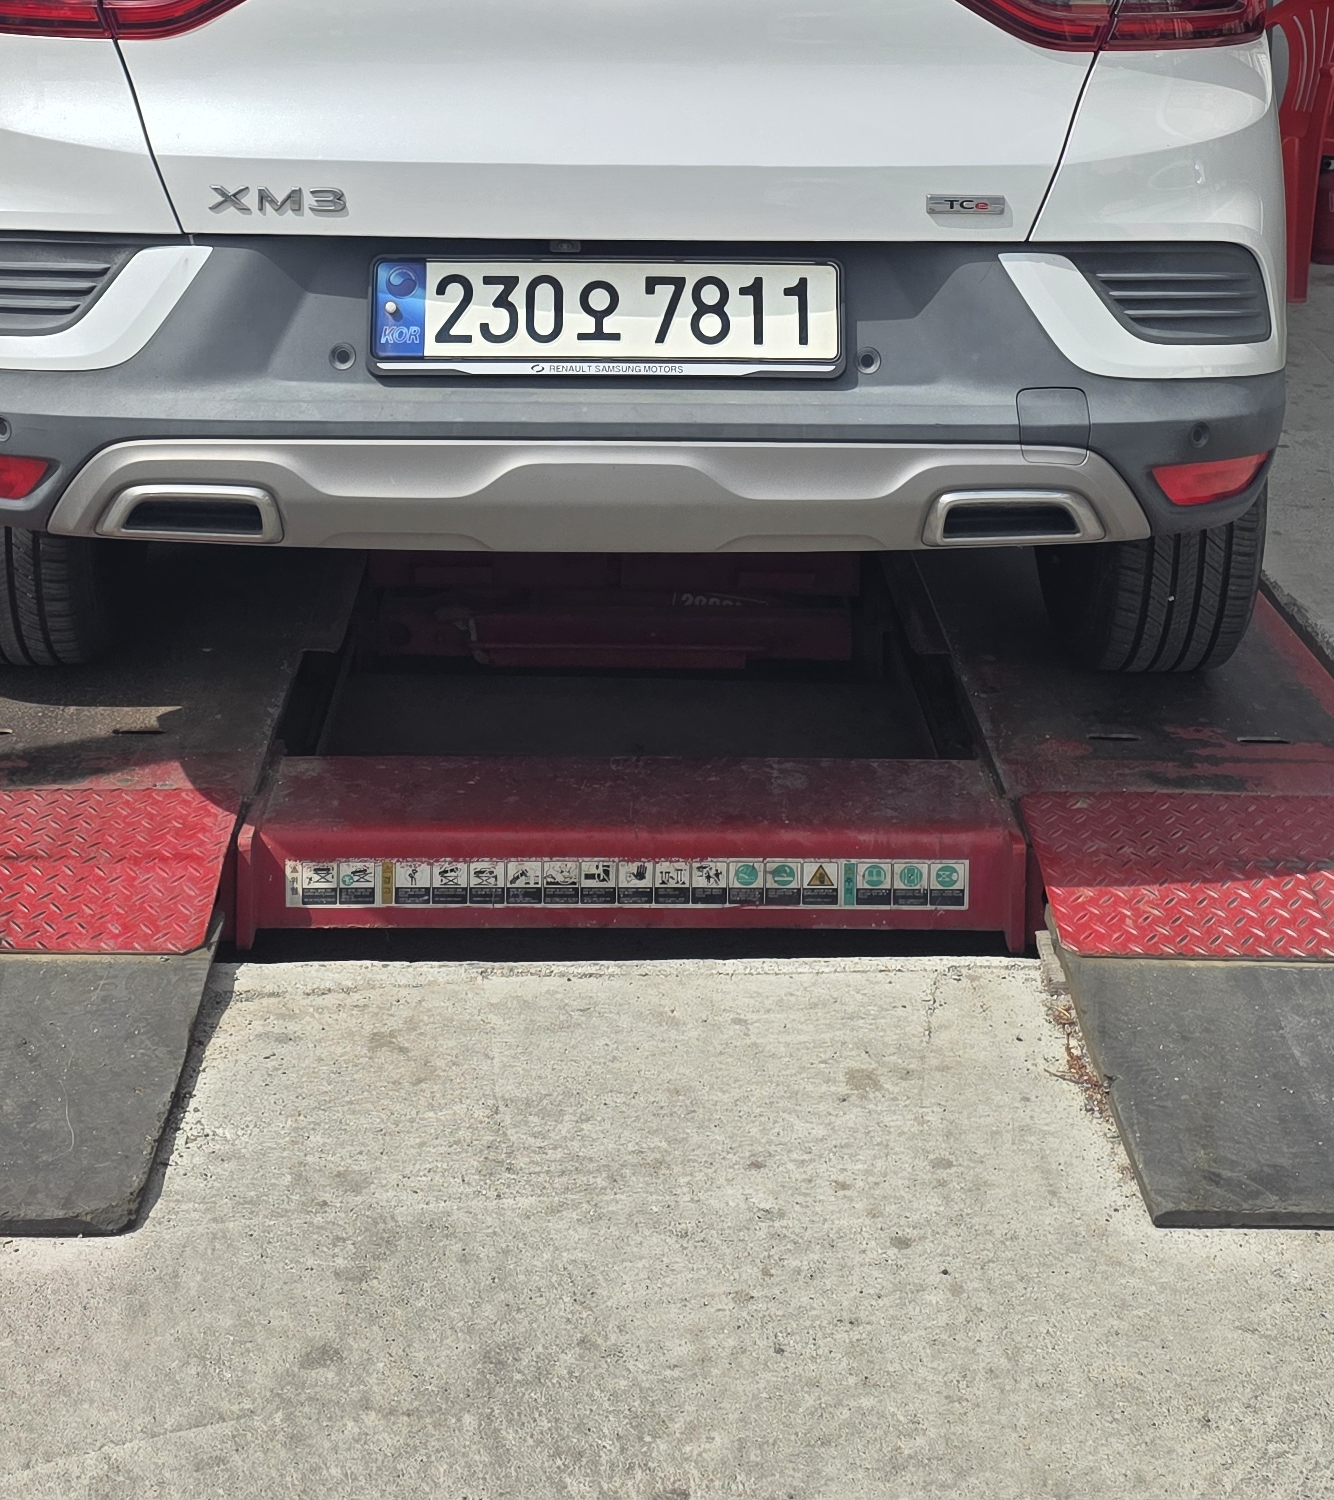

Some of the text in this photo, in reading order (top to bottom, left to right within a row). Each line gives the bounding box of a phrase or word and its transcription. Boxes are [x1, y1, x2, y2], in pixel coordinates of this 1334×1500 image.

[208, 185, 347, 212] XM3
[944, 199, 989, 210] TCe
[434, 274, 809, 346] 230오 7811
[380, 325, 421, 344] KOR
[549, 365, 684, 373] RENAULT SAMSUNG MOTORS
